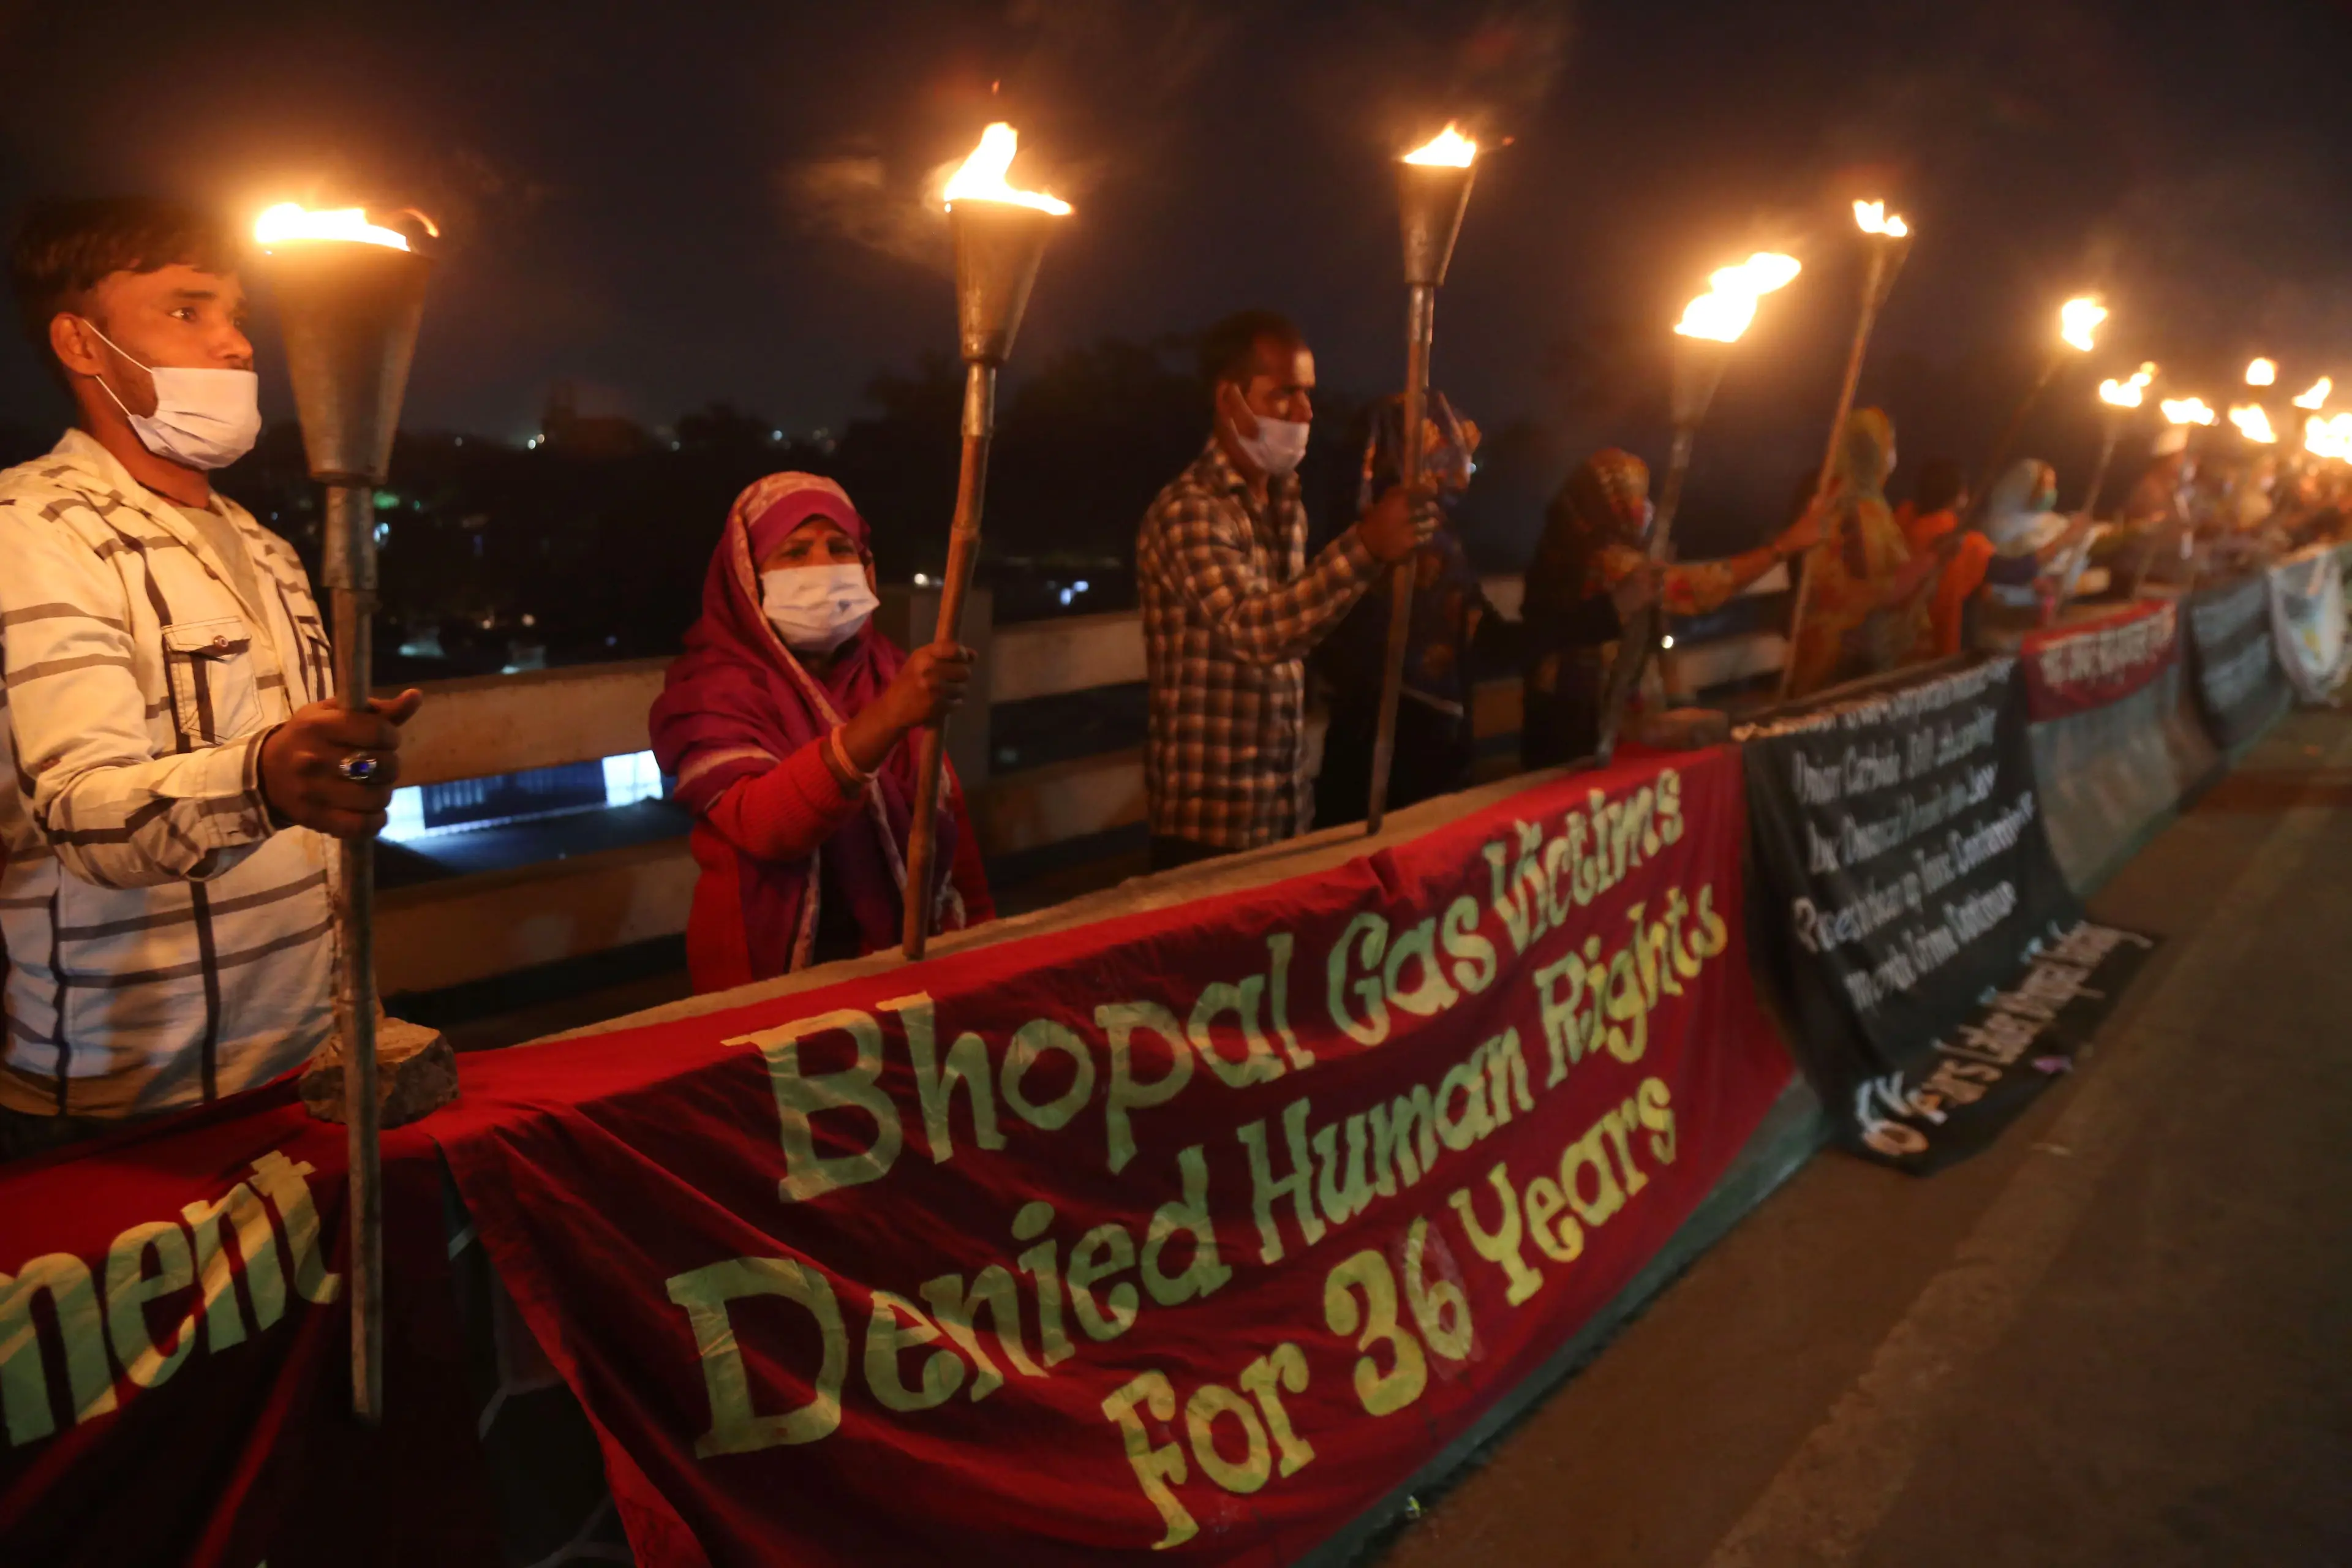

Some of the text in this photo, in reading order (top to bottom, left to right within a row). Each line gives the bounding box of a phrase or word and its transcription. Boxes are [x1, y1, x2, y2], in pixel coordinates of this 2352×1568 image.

[665, 1144, 1232, 1460] Denied
[1237, 1027, 1534, 1265] Human
[1533, 884, 1727, 1088] Rights
[720, 933, 1315, 1202] Bhopal
[1326, 895, 1497, 1046] Gas
[1481, 768, 1684, 956] Victims
[1102, 1077, 1676, 1551] For 36 Years
